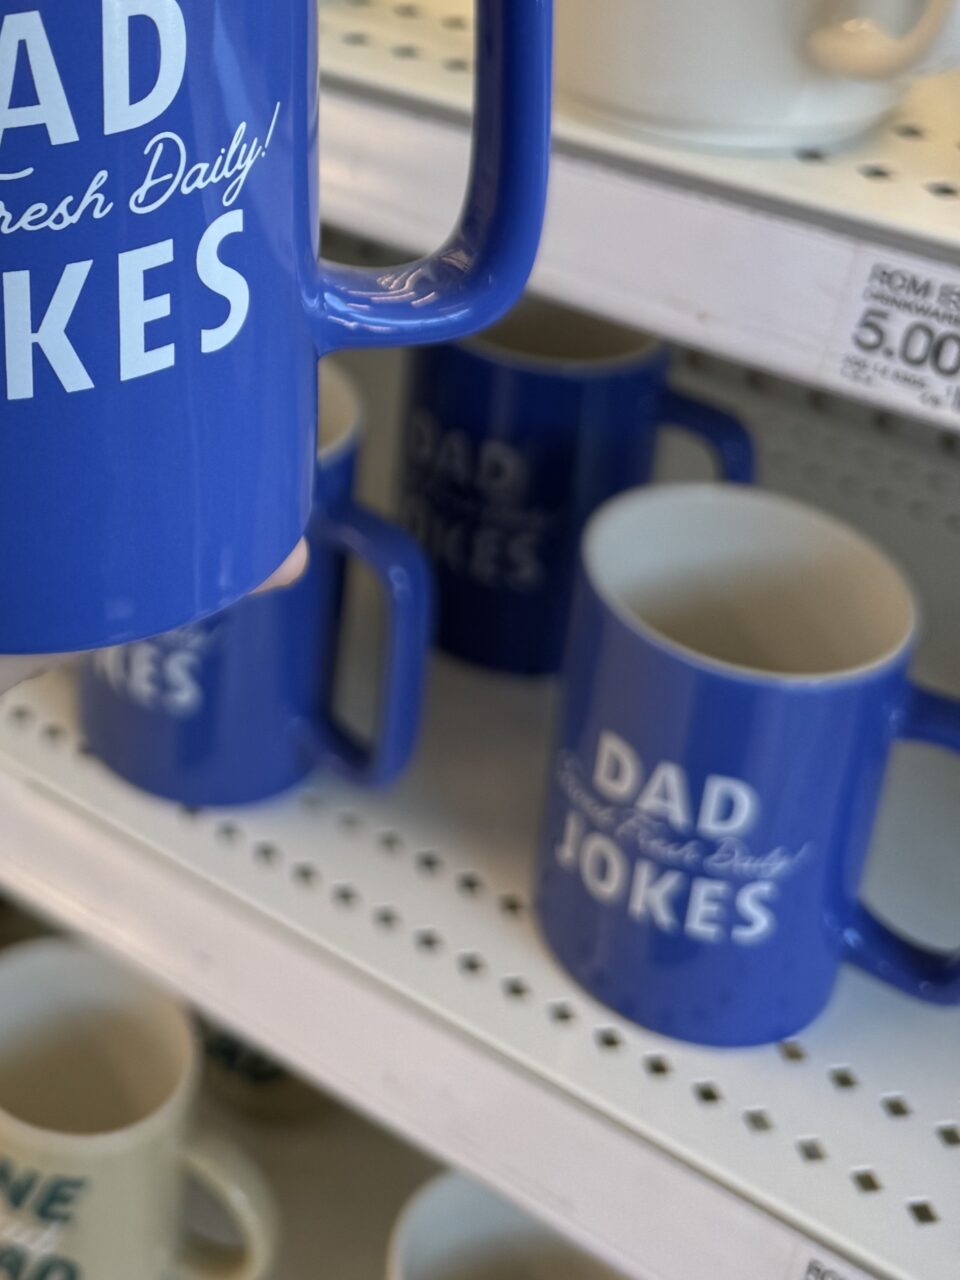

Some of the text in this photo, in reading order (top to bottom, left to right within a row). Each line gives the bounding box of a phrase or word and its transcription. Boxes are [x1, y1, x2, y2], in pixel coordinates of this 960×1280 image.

[128, 101, 281, 215] Daily!
[852, 307, 960, 377] 5.00
[594, 729, 760, 841] DAD
[555, 809, 777, 946] JOKES
